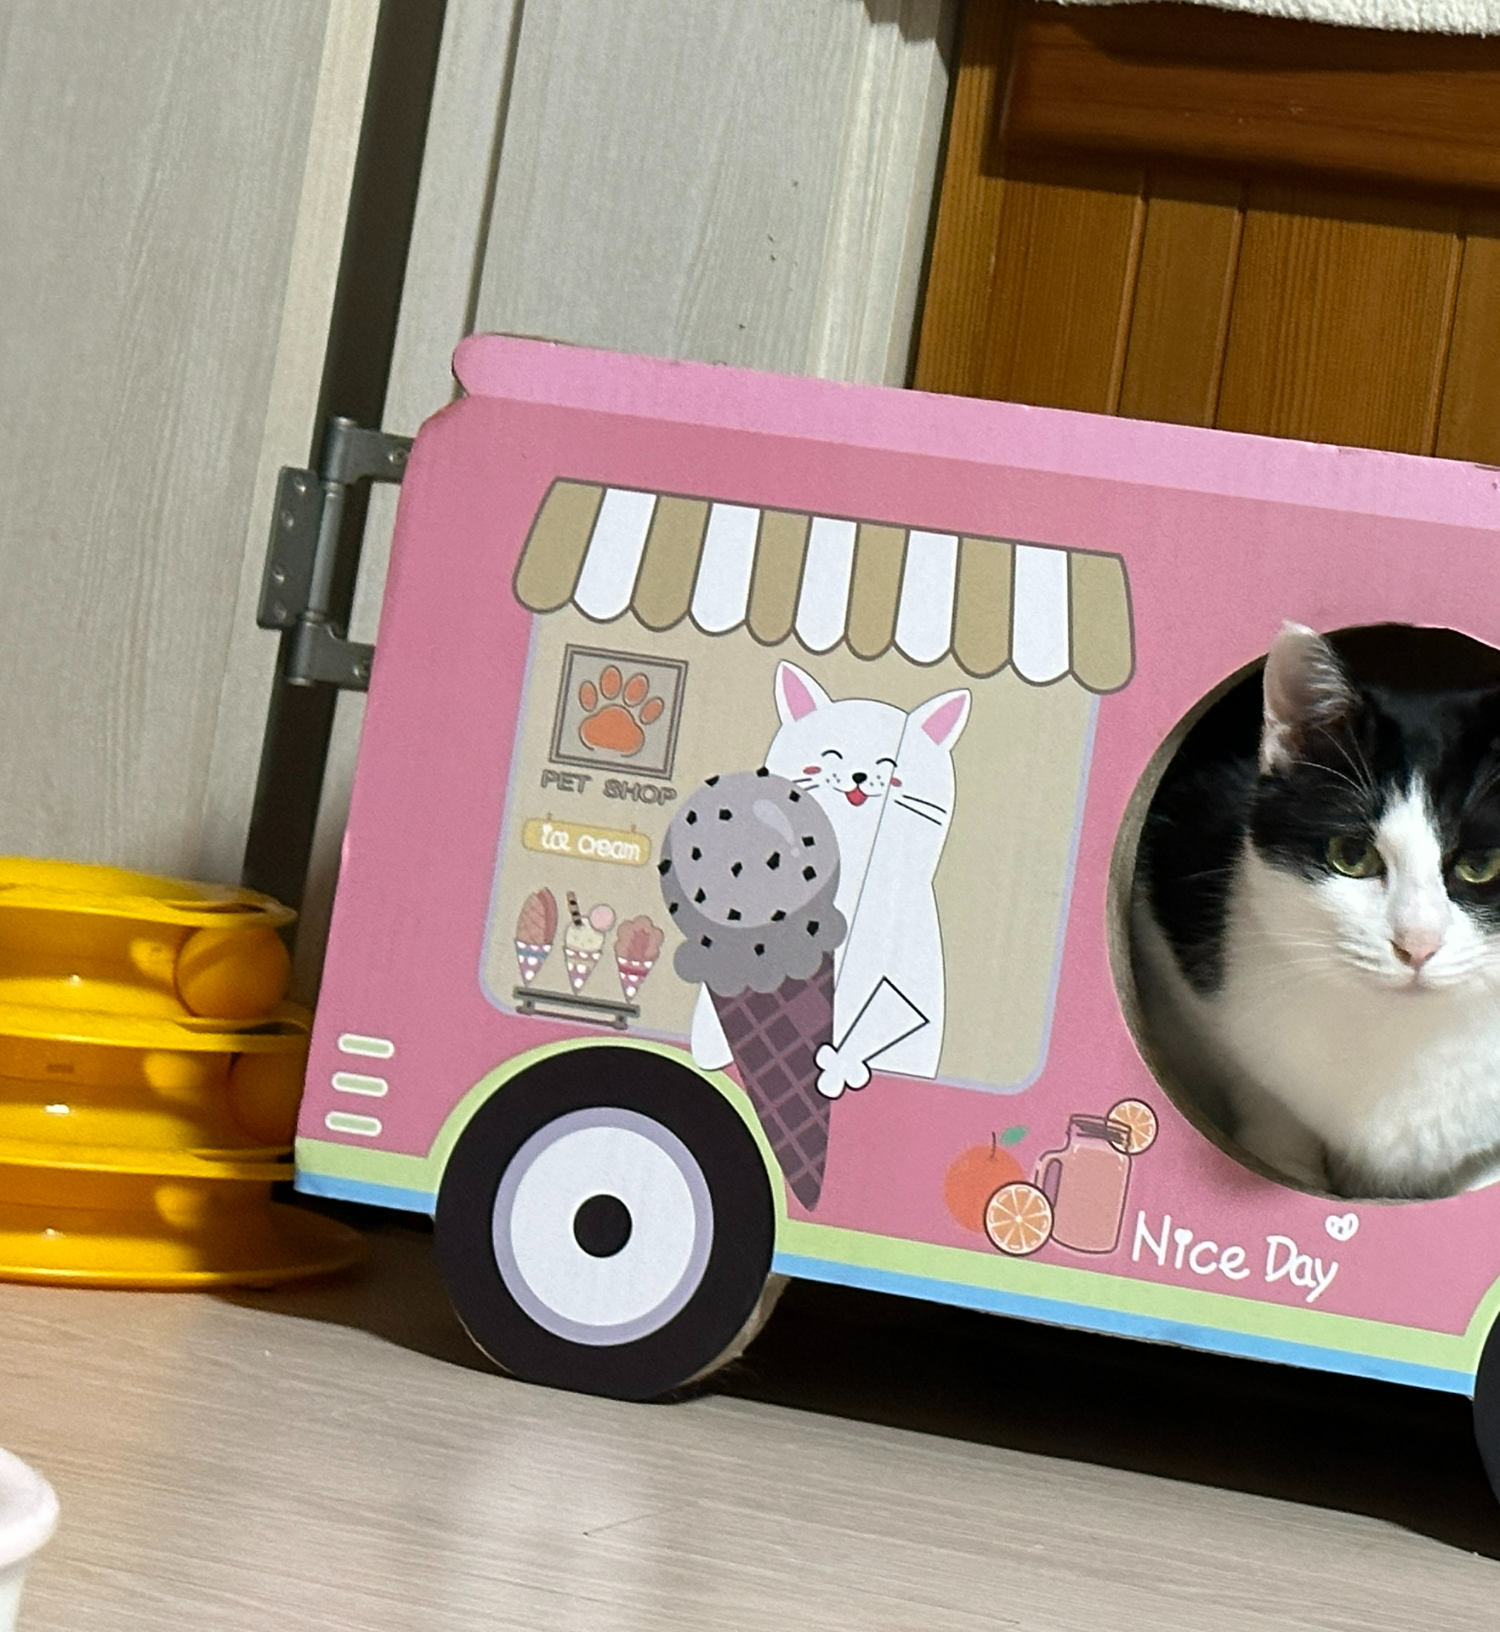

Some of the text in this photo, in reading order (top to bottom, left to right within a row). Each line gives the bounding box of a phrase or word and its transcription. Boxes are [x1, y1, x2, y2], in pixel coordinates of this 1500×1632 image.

[541, 769, 677, 806] PET SHOP
[1132, 1210, 1338, 1303] Nice Day
